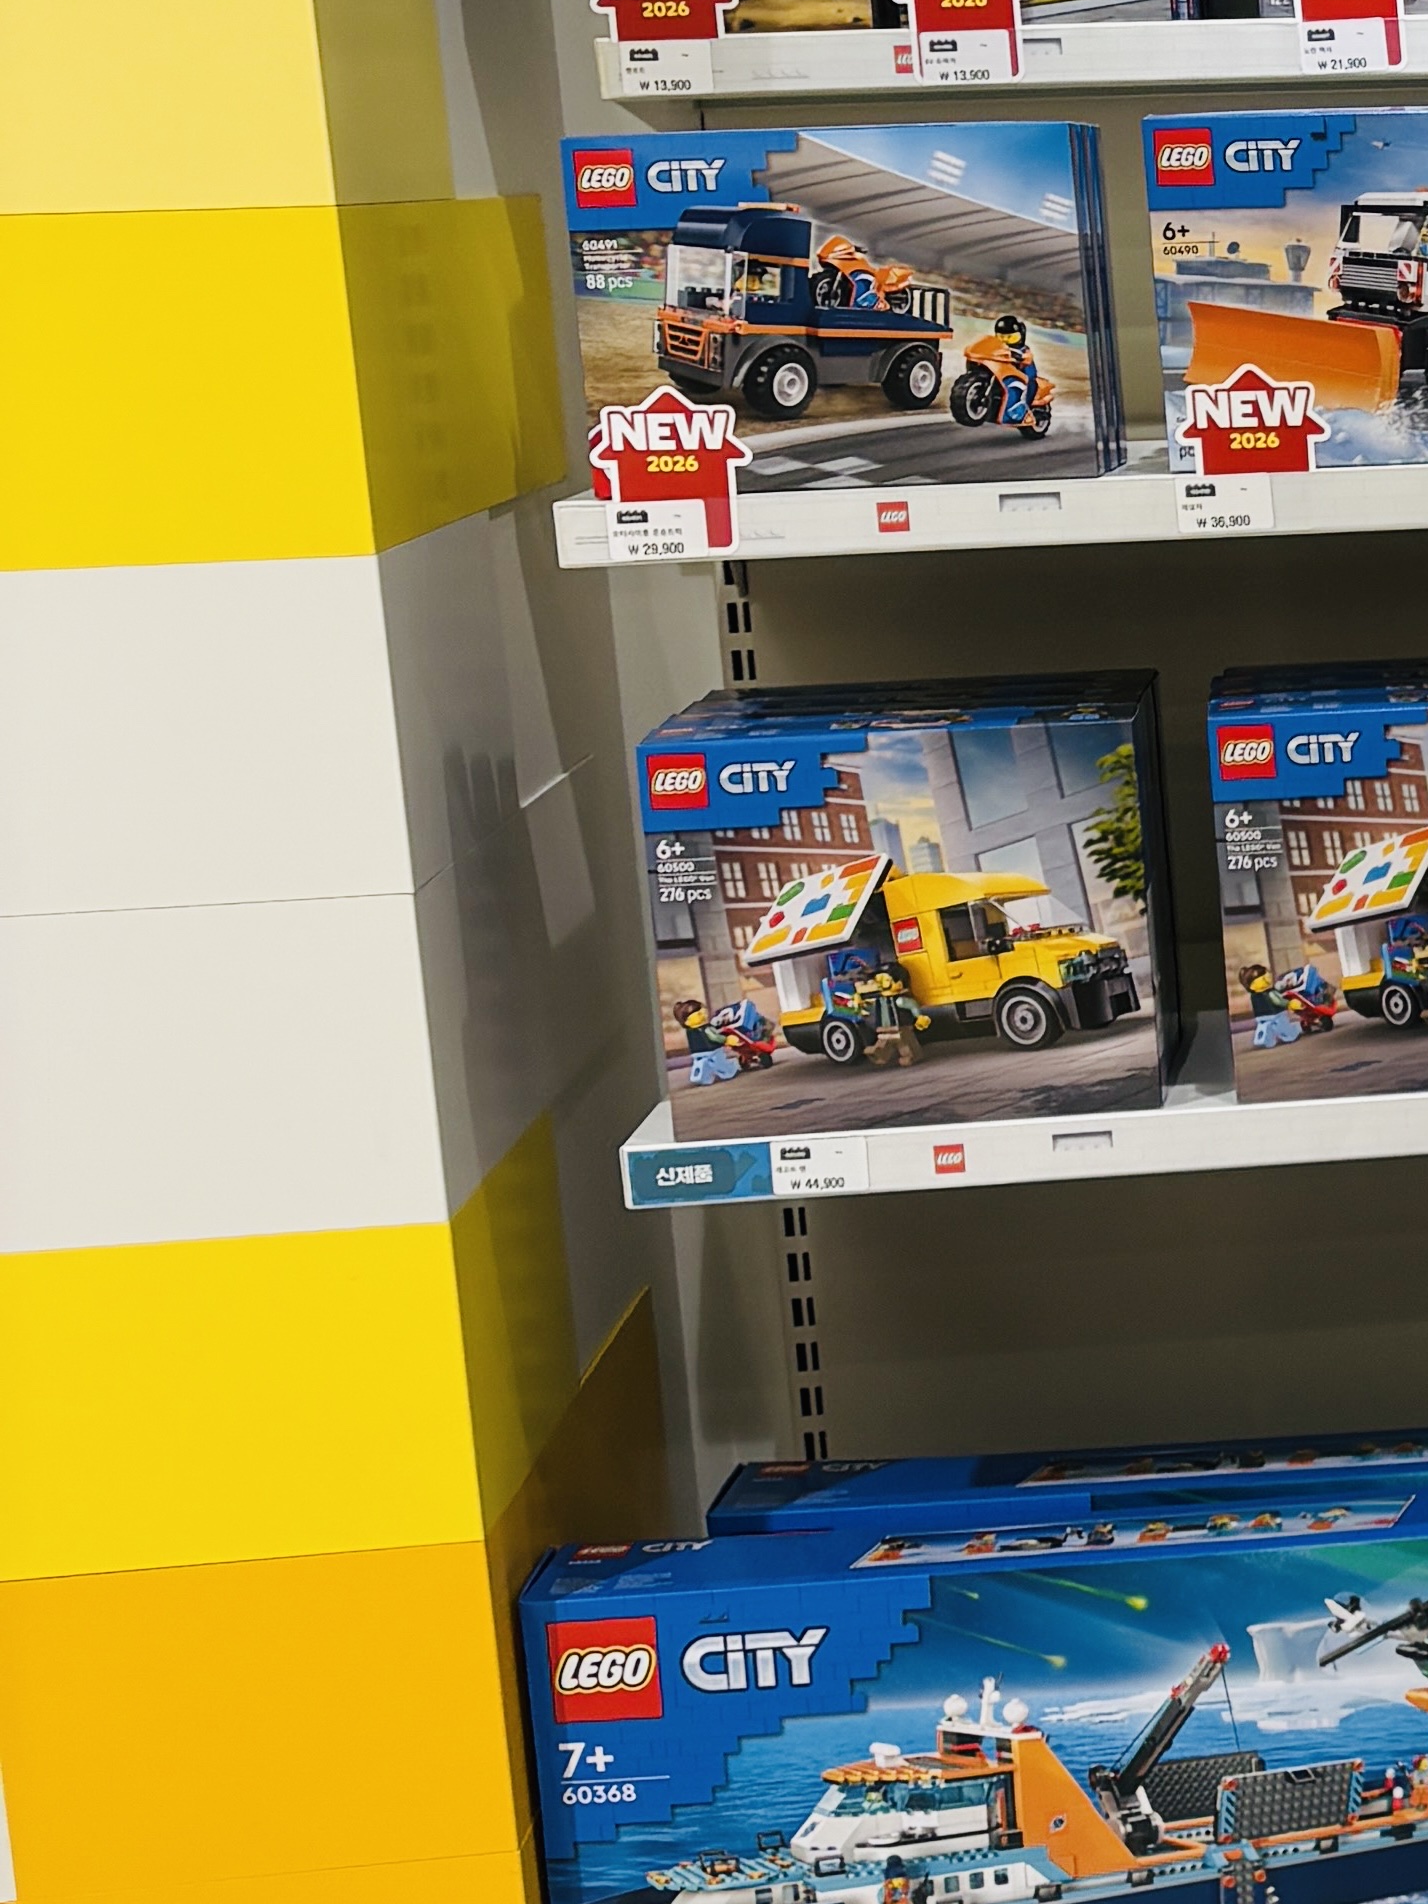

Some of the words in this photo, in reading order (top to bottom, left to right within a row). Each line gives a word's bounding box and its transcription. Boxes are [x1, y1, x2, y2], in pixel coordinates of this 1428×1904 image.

[642, 2, 690, 18] 2026
[1163, 222, 1190, 241] 6+
[582, 240, 617, 251] 60491
[1163, 244, 1199, 256] 60490
[1194, 390, 1309, 430] NEW
[608, 412, 730, 452] NEW
[1229, 433, 1280, 449] 2026
[646, 455, 699, 473] 2026
[651, 766, 705, 795] LEGO
[719, 760, 796, 794] CITY
[1225, 809, 1253, 827] 6+
[1225, 831, 1261, 842] 60500
[656, 841, 685, 858] 6+
[657, 861, 694, 873] 60500
[659, 887, 685, 902] 276
[687, 888, 712, 903] pcs
[656, 1165, 712, 1186] 신제품
[555, 1644, 656, 1695] LEGO
[680, 1625, 830, 1692] CITY
[558, 1743, 614, 1778] 7+
[562, 1784, 636, 1804] 60368
